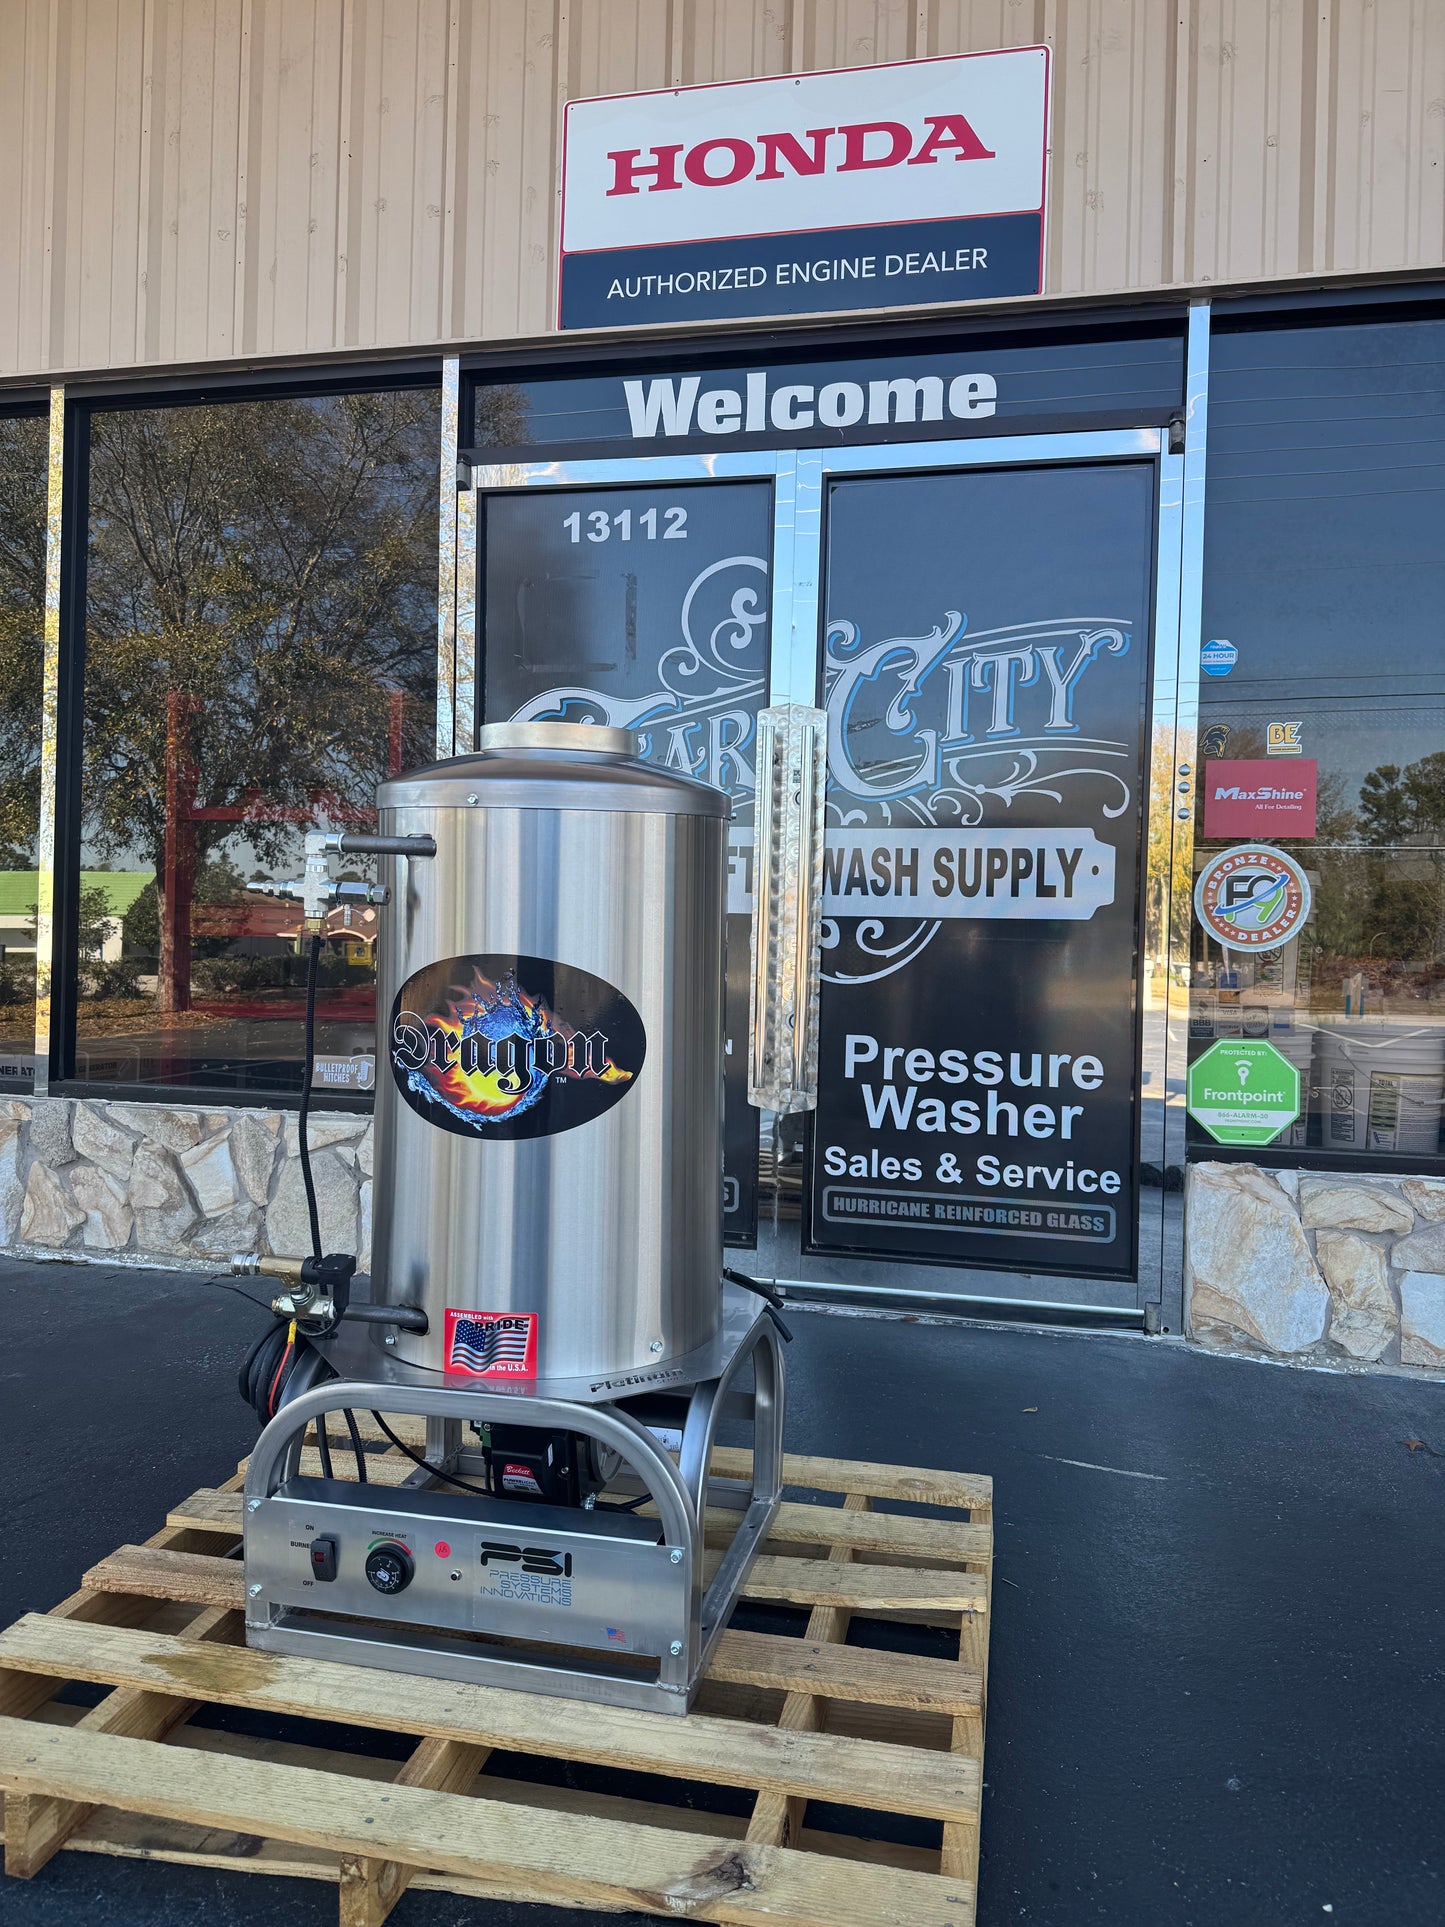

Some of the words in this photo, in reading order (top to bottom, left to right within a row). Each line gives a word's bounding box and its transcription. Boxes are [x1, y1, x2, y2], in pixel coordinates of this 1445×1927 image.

[606, 114, 996, 196] HONDA
[607, 266, 767, 299] AUTHORIZED
[776, 256, 876, 285] ENGINE
[885, 248, 988, 276] DEALER
[623, 372, 998, 438] Welcome
[563, 507, 688, 543] 13112
[1269, 724, 1298, 744] BE
[1215, 787, 1304, 801] MaxShine
[822, 847, 919, 896] WASH
[932, 847, 1084, 898] SUPPLY
[1208, 855, 1269, 890] BRONZE
[1237, 909, 1297, 942] DEALER
[393, 1011, 609, 1095] Dragon
[844, 1034, 1104, 1090] Pressure
[315, 1062, 359, 1074] BULLETPROOF
[323, 1073, 351, 1083] HITCHES
[1204, 1088, 1283, 1105] Frontpoint
[861, 1084, 1083, 1139] Washer
[824, 1146, 922, 1181] Sales
[935, 1153, 963, 1184] &
[976, 1155, 1121, 1194] Service
[833, 1196, 930, 1218] HURRICANE
[934, 1204, 1042, 1227] REINFORCED
[1046, 1213, 1105, 1232] GLASS
[450, 1312, 482, 1320] ASSEMBLED
[474, 1319, 525, 1331] PRIDE
[507, 1364, 529, 1372] U.S.A.
[290, 1541, 310, 1549] BURNE
[372, 1530, 394, 1538] INCREASE
[481, 1541, 573, 1578] PSI
[490, 1569, 572, 1589] PRESSURE
[500, 1580, 572, 1598] SYSTEMS
[480, 1586, 572, 1607] INNOVATIONS
